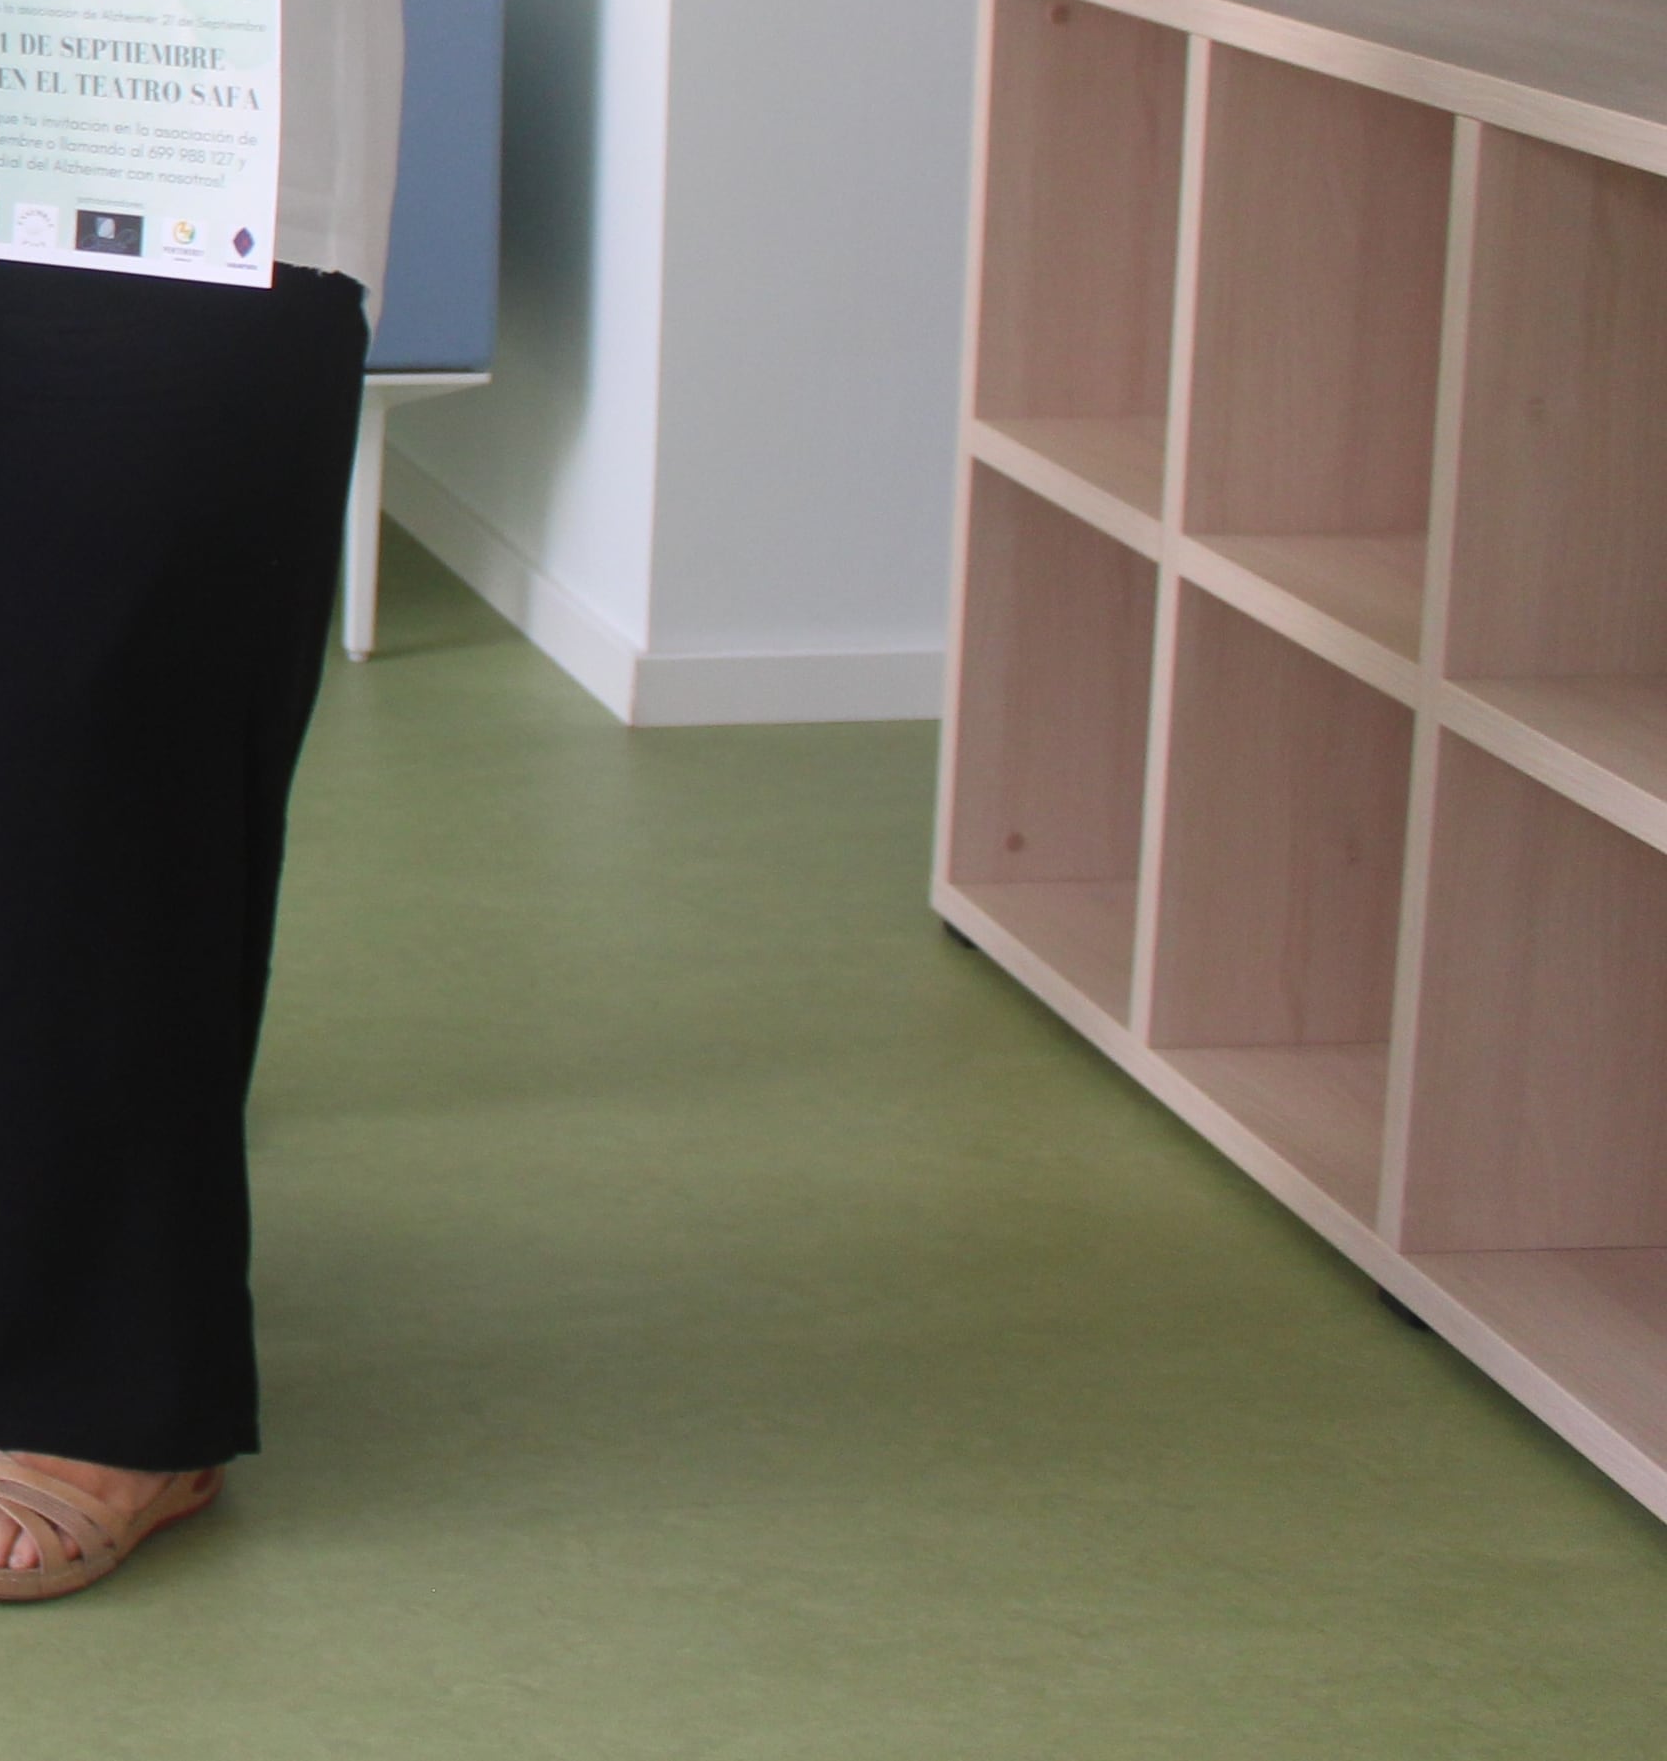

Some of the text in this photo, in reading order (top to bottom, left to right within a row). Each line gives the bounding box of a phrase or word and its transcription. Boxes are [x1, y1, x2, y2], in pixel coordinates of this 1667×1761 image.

[19, 33, 51, 56] DE
[60, 37, 226, 69] SEPTIEMBRE
[36, 70, 66, 94] EL
[75, 74, 184, 102] TEATRO
[190, 83, 259, 110] SAFA
